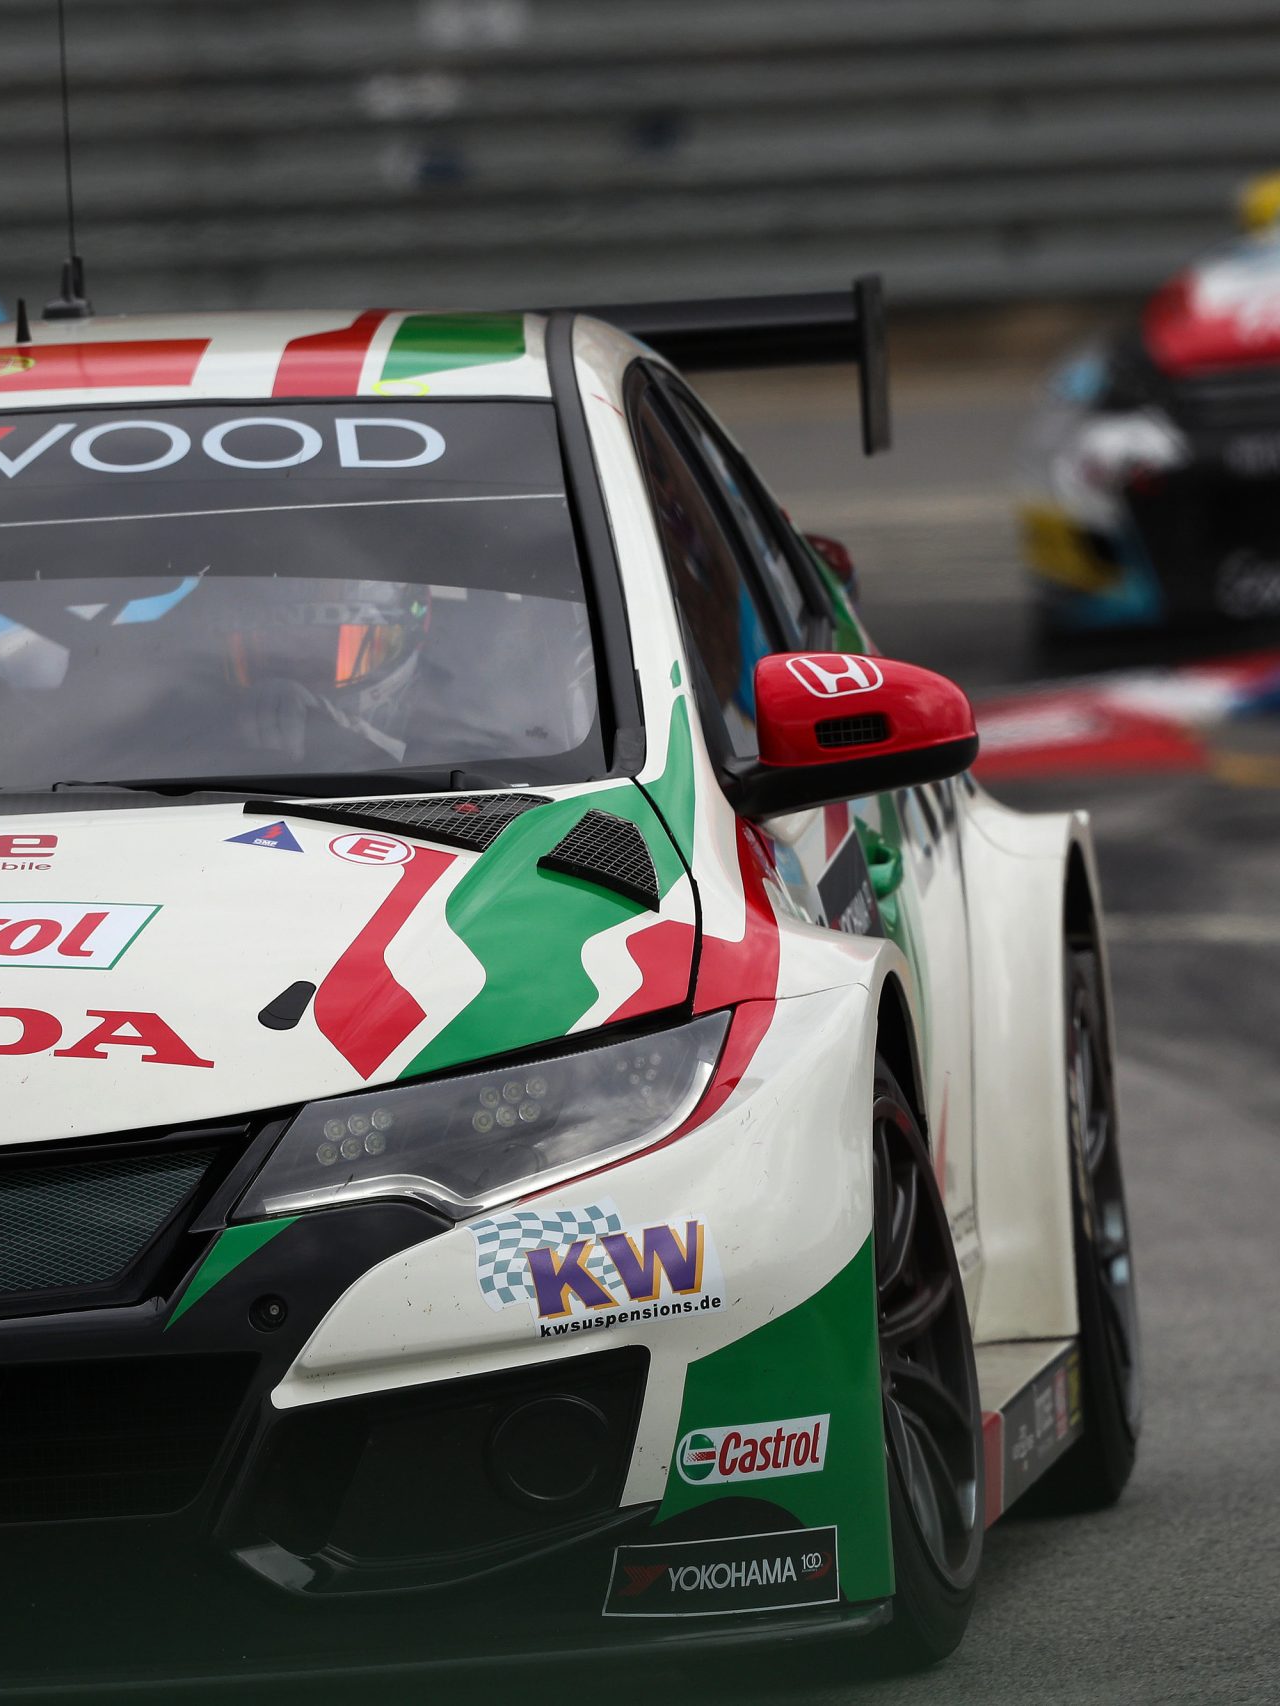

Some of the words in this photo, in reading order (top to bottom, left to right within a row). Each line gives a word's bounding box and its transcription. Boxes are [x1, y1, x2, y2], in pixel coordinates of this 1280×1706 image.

[346, 837, 397, 861] E
[524, 1219, 706, 1319] KW
[538, 1294, 721, 1338] kwsuspensions.de
[718, 1422, 822, 1476] Castrol
[668, 1556, 797, 1592] YOKOHAMA
